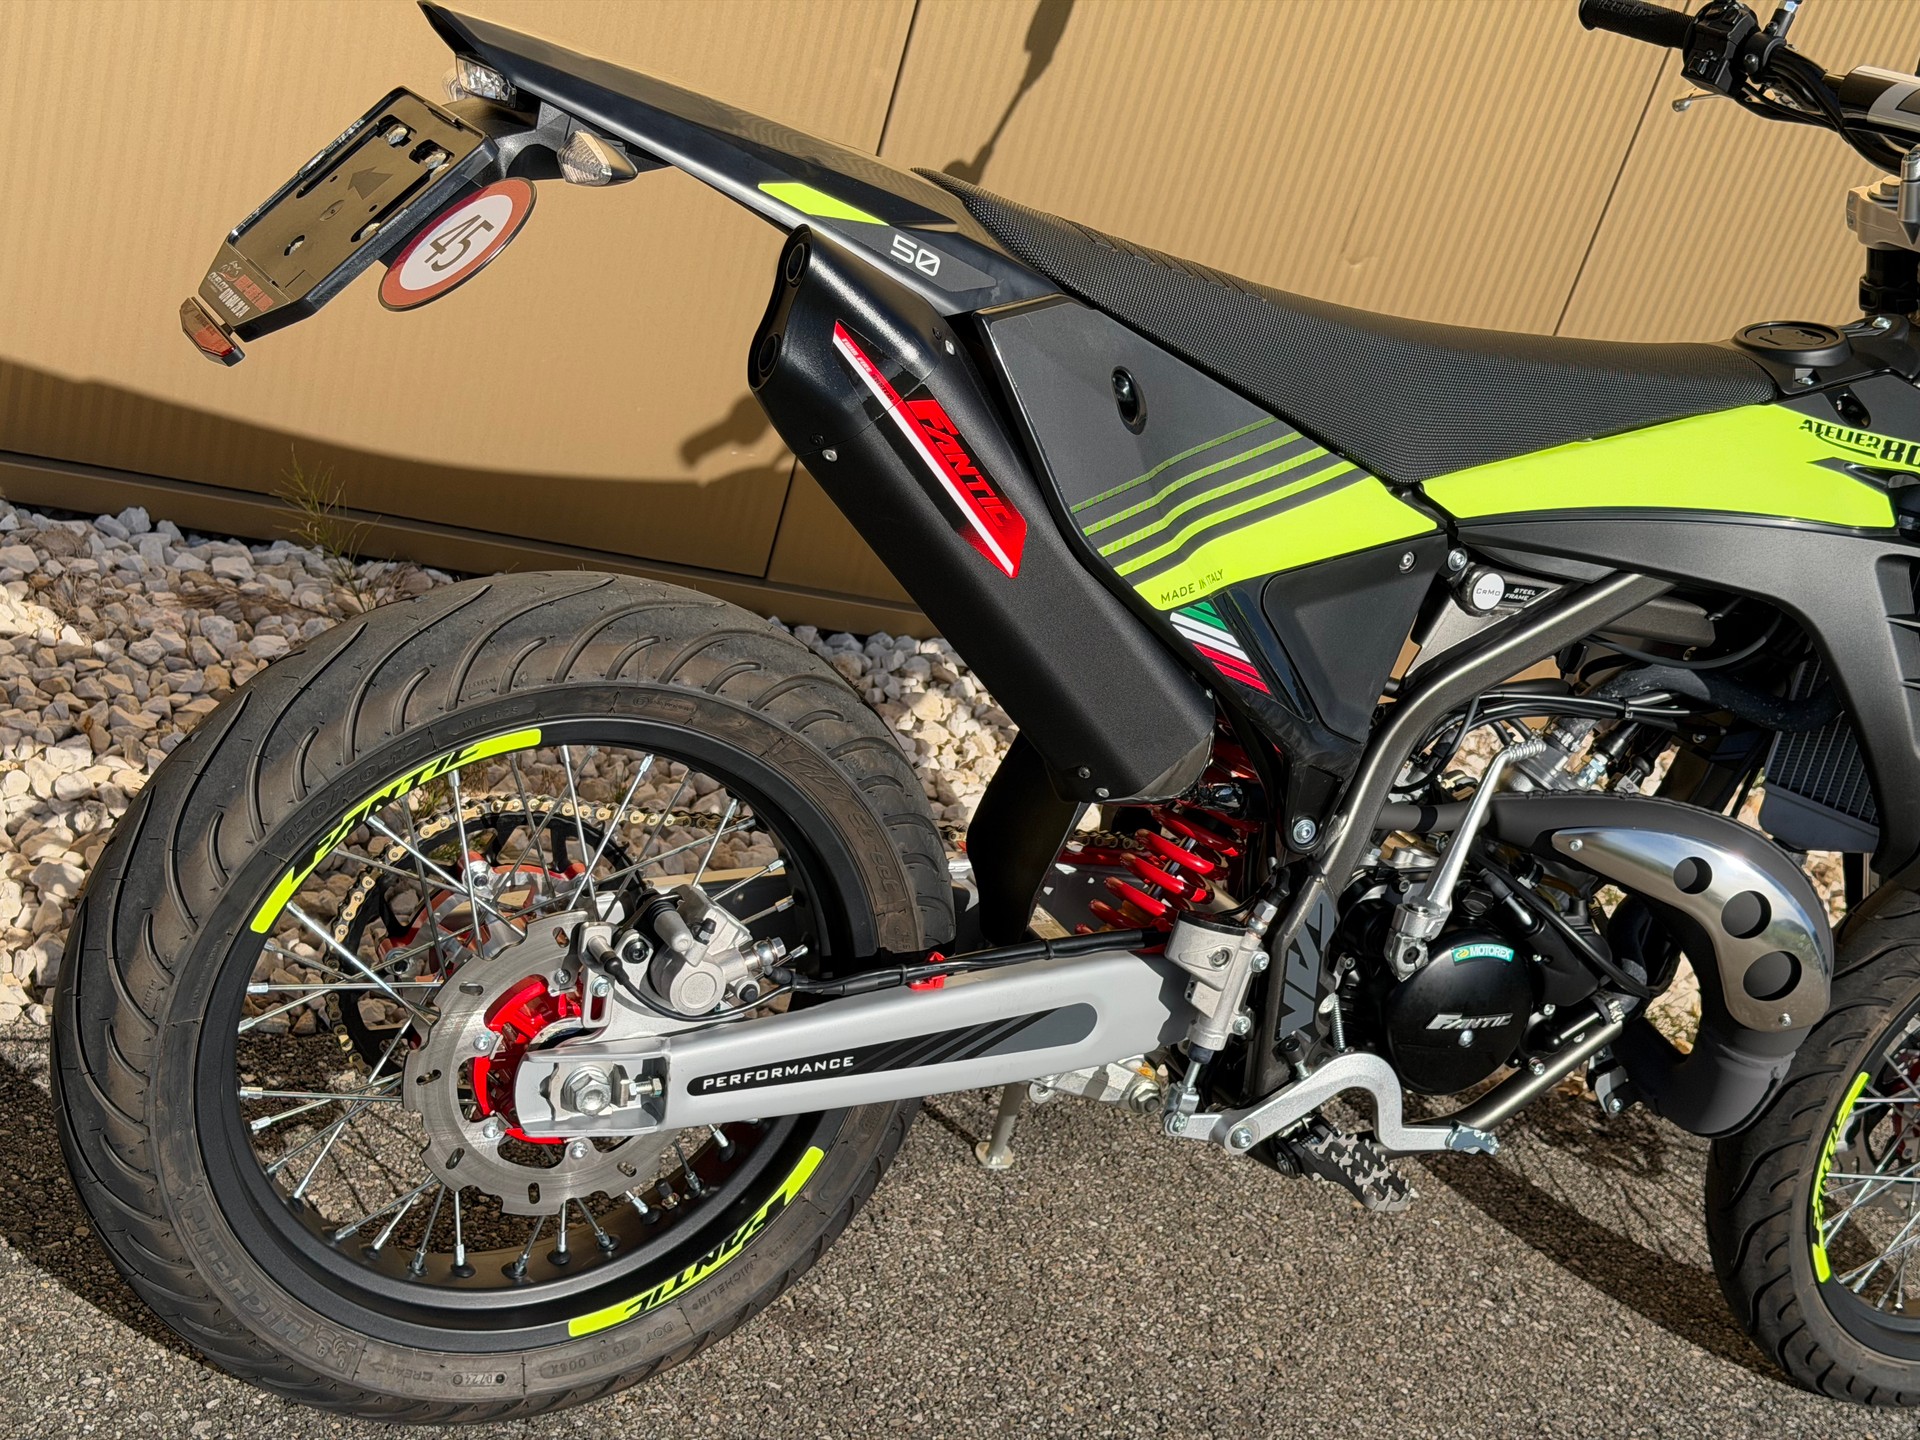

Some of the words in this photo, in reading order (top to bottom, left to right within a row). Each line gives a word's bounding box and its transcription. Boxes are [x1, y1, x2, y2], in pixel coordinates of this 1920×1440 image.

[425, 214, 494, 272] 45
[889, 234, 941, 277] 50
[1799, 419, 1881, 450] ATELIER
[917, 404, 1010, 528] FANTIC
[1160, 583, 1195, 604] MADE
[1198, 577, 1207, 590] IN
[1206, 569, 1224, 585] ITALY
[1504, 593, 1530, 601] FRAME
[1513, 588, 1536, 596] STEEL
[290, 743, 485, 888] FANTIC
[1470, 946, 1513, 959] MOTOREX
[1425, 1013, 1514, 1030] FANTIC
[702, 1056, 855, 1090] PERFORMANCE
[624, 1190, 787, 1318] FANTIC
[643, 1320, 675, 1344] DOT
